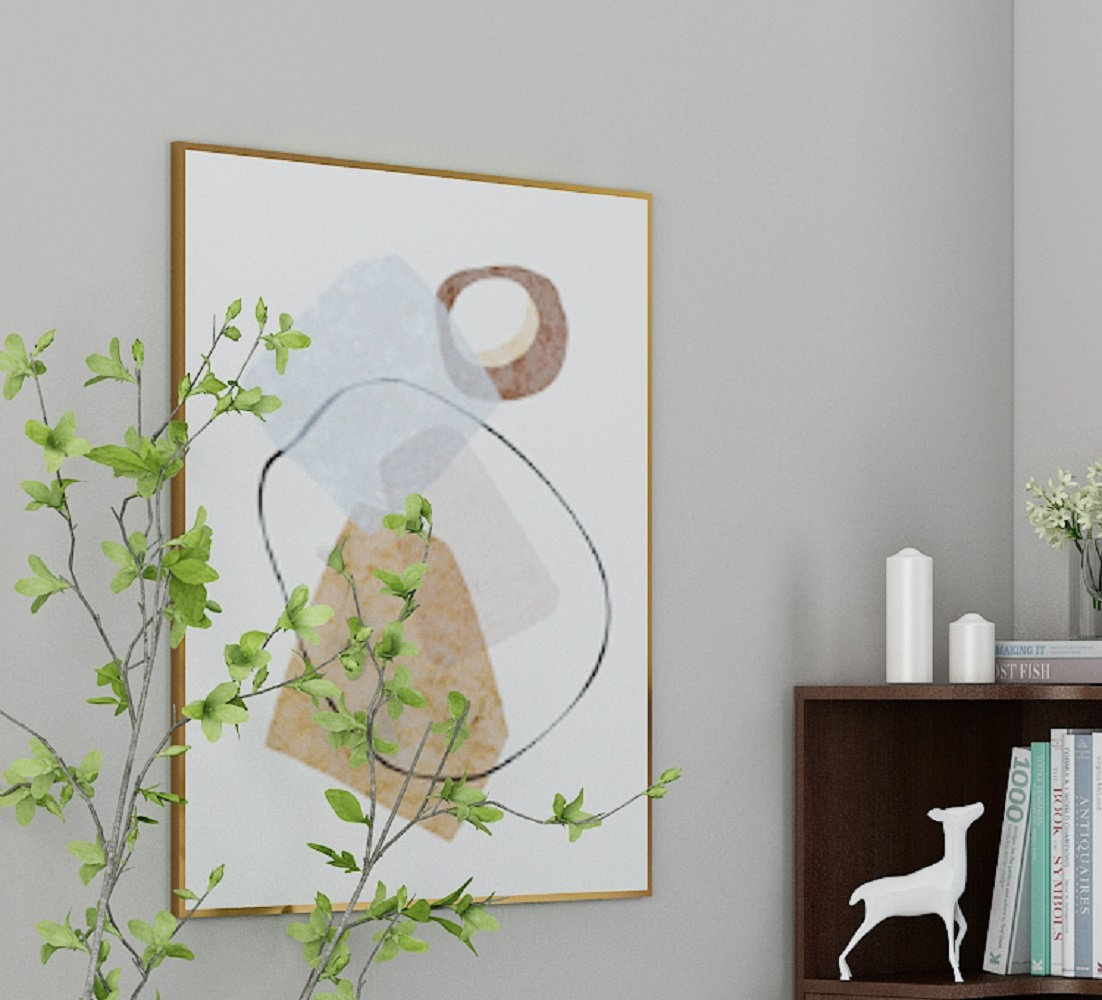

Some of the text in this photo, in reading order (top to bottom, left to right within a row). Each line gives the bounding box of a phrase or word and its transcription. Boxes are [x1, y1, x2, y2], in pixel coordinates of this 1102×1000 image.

[1020, 663, 1050, 680] FISH
[1035, 645, 1046, 656] IT
[1006, 756, 1030, 823] 1000
[1053, 788, 1063, 836] BOOK
[1079, 795, 1090, 915] ANTIQUAIRES
[1053, 856, 1063, 942] SYMBOLS
